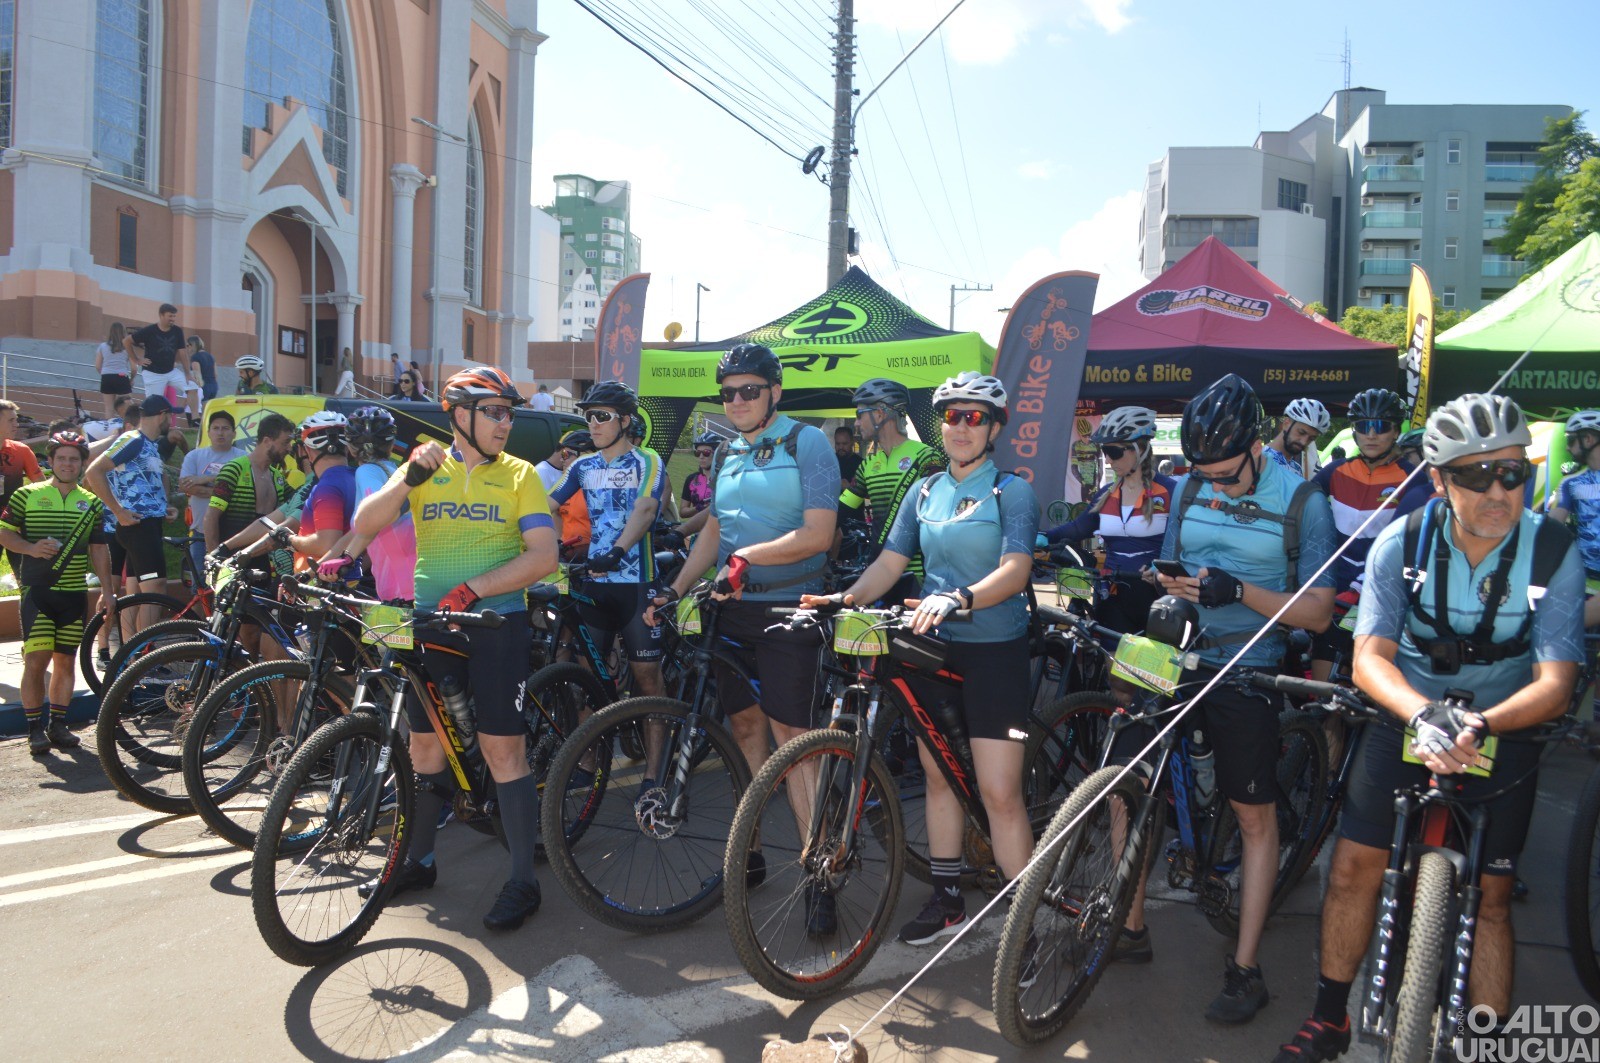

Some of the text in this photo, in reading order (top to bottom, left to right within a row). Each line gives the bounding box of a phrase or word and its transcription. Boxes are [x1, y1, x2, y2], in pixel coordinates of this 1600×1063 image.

[1173, 287, 1264, 311] BARRIL
[652, 367, 671, 378] VISTA
[672, 367, 686, 378] SUA
[779, 353, 861, 372] RT
[886, 357, 910, 368] VISTA
[911, 356, 928, 367] SUA
[1085, 364, 1193, 383] Moto & Bike
[1015, 354, 1053, 414] Bike
[1263, 369, 1350, 384] (55) 3744-6681
[1498, 370, 1600, 390] TARTARUG
[1011, 421, 1042, 458] da
[903, 468, 918, 486] TEAM
[422, 501, 507, 523] BRASIL
[230, 673, 286, 700] ALEXRIMS
[426, 681, 465, 752] OGGI
[912, 704, 967, 780] OGGI
[381, 813, 406, 884] ALEXRIMS
[1370, 896, 1398, 1003] MANITOU
[1447, 914, 1474, 1023] MANITOU
